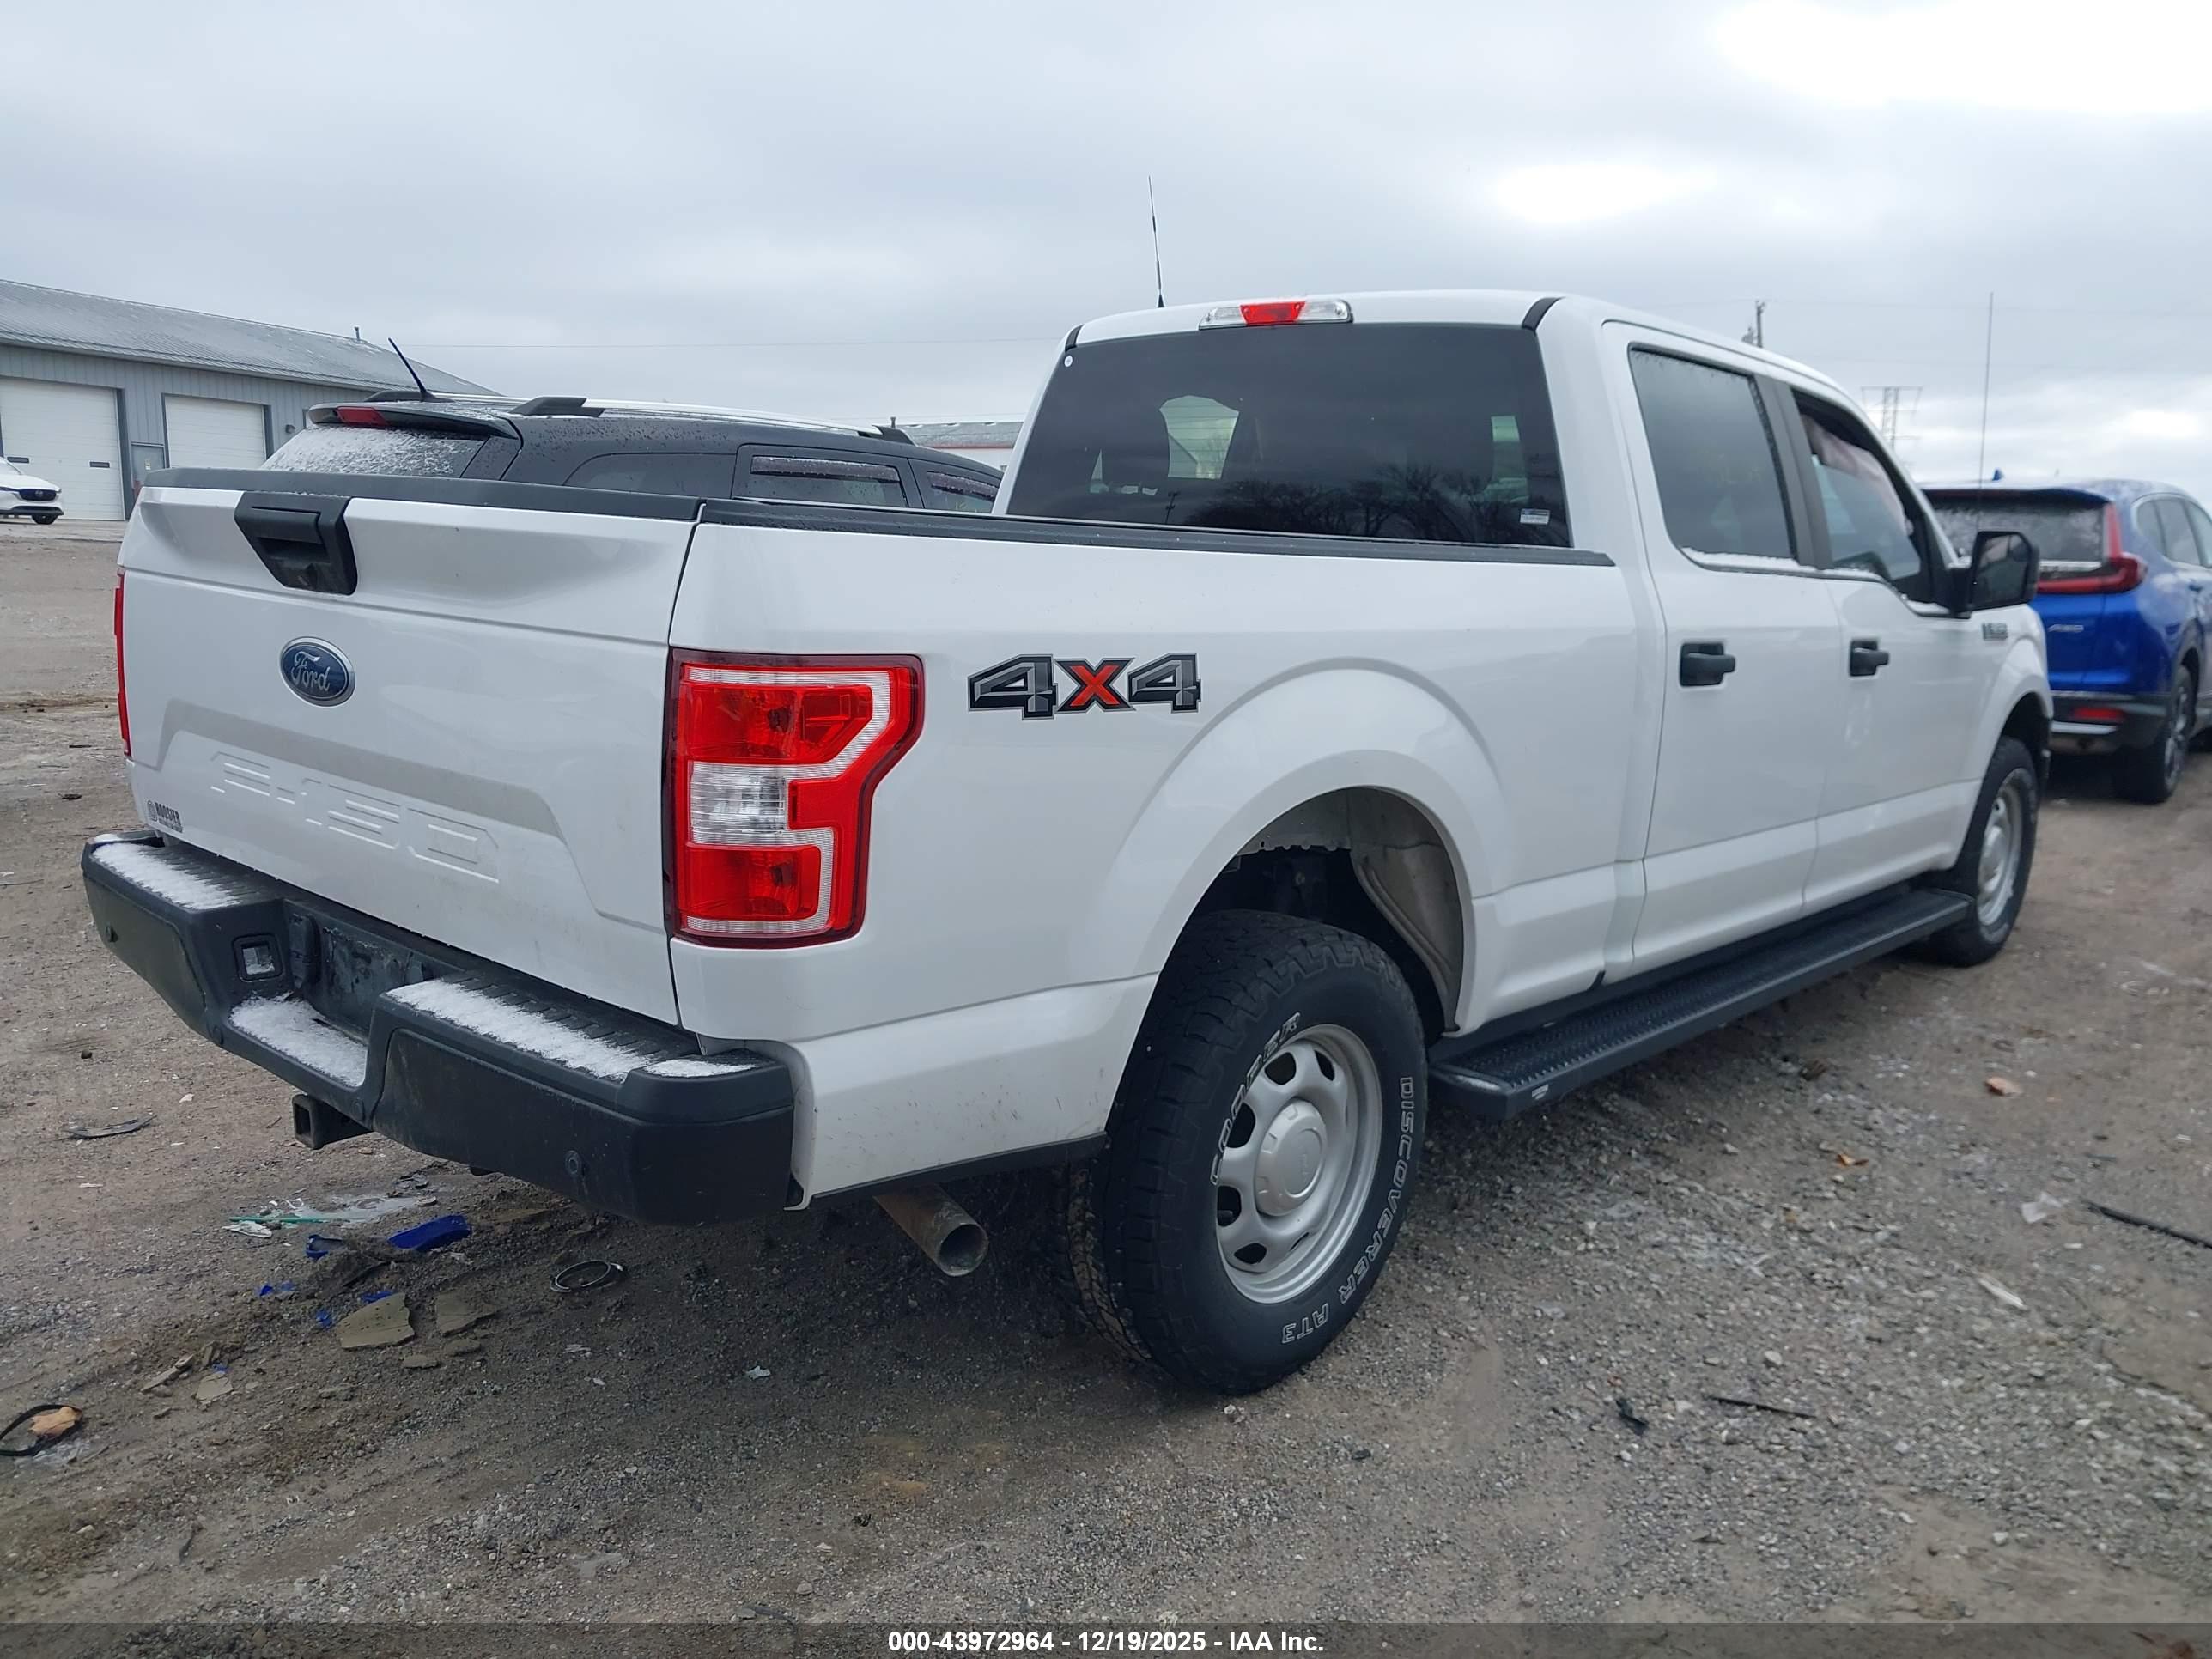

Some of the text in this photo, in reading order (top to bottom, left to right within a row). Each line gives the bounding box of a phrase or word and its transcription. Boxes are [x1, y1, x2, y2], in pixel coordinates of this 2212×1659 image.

[290, 650, 331, 692] Ford
[210, 750, 501, 884] F-150
[1281, 1076, 1417, 1344] DISCOVERER AT3
